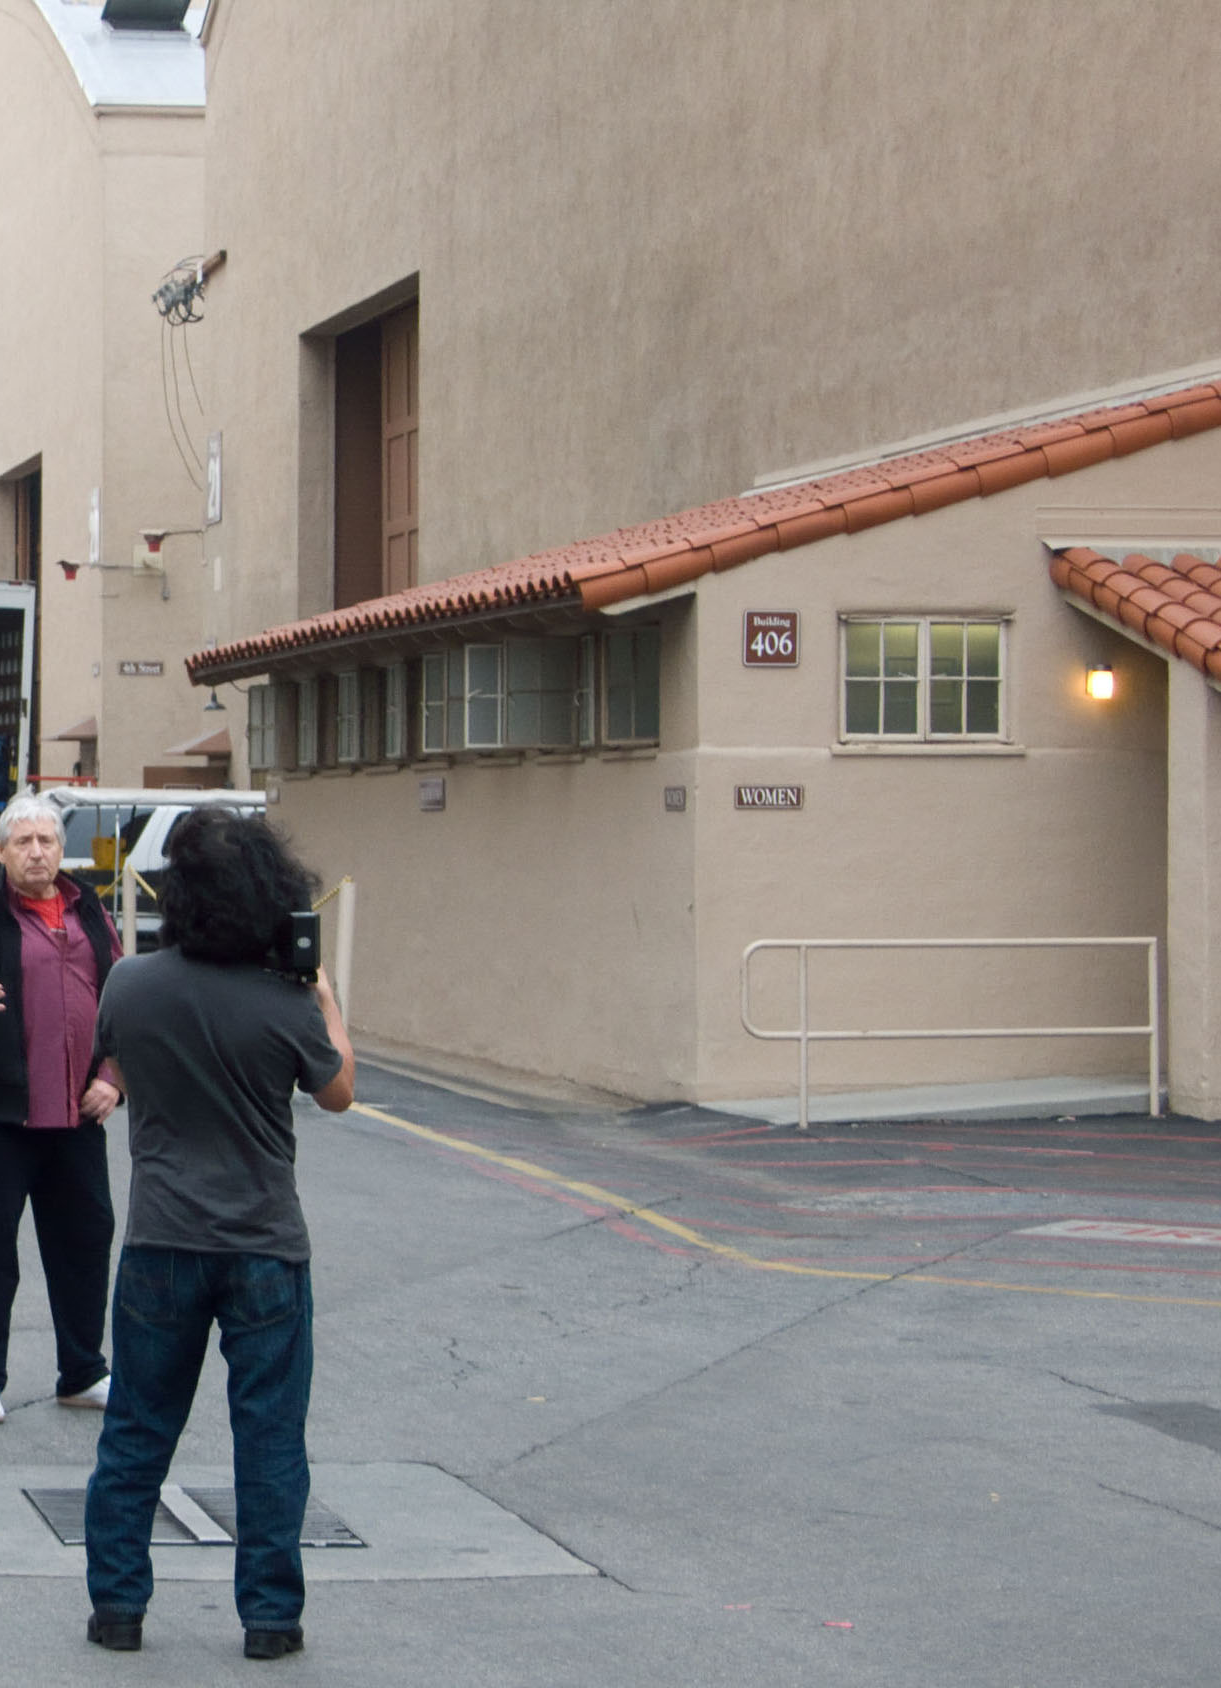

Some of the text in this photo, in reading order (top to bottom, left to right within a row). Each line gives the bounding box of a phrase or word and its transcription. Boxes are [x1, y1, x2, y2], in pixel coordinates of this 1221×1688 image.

[753, 615, 791, 628] Building
[750, 631, 793, 657] 406
[122, 663, 160, 673] 4th Street
[740, 788, 798, 805] WOMEN
[1067, 1223, 1221, 1241] FIR
